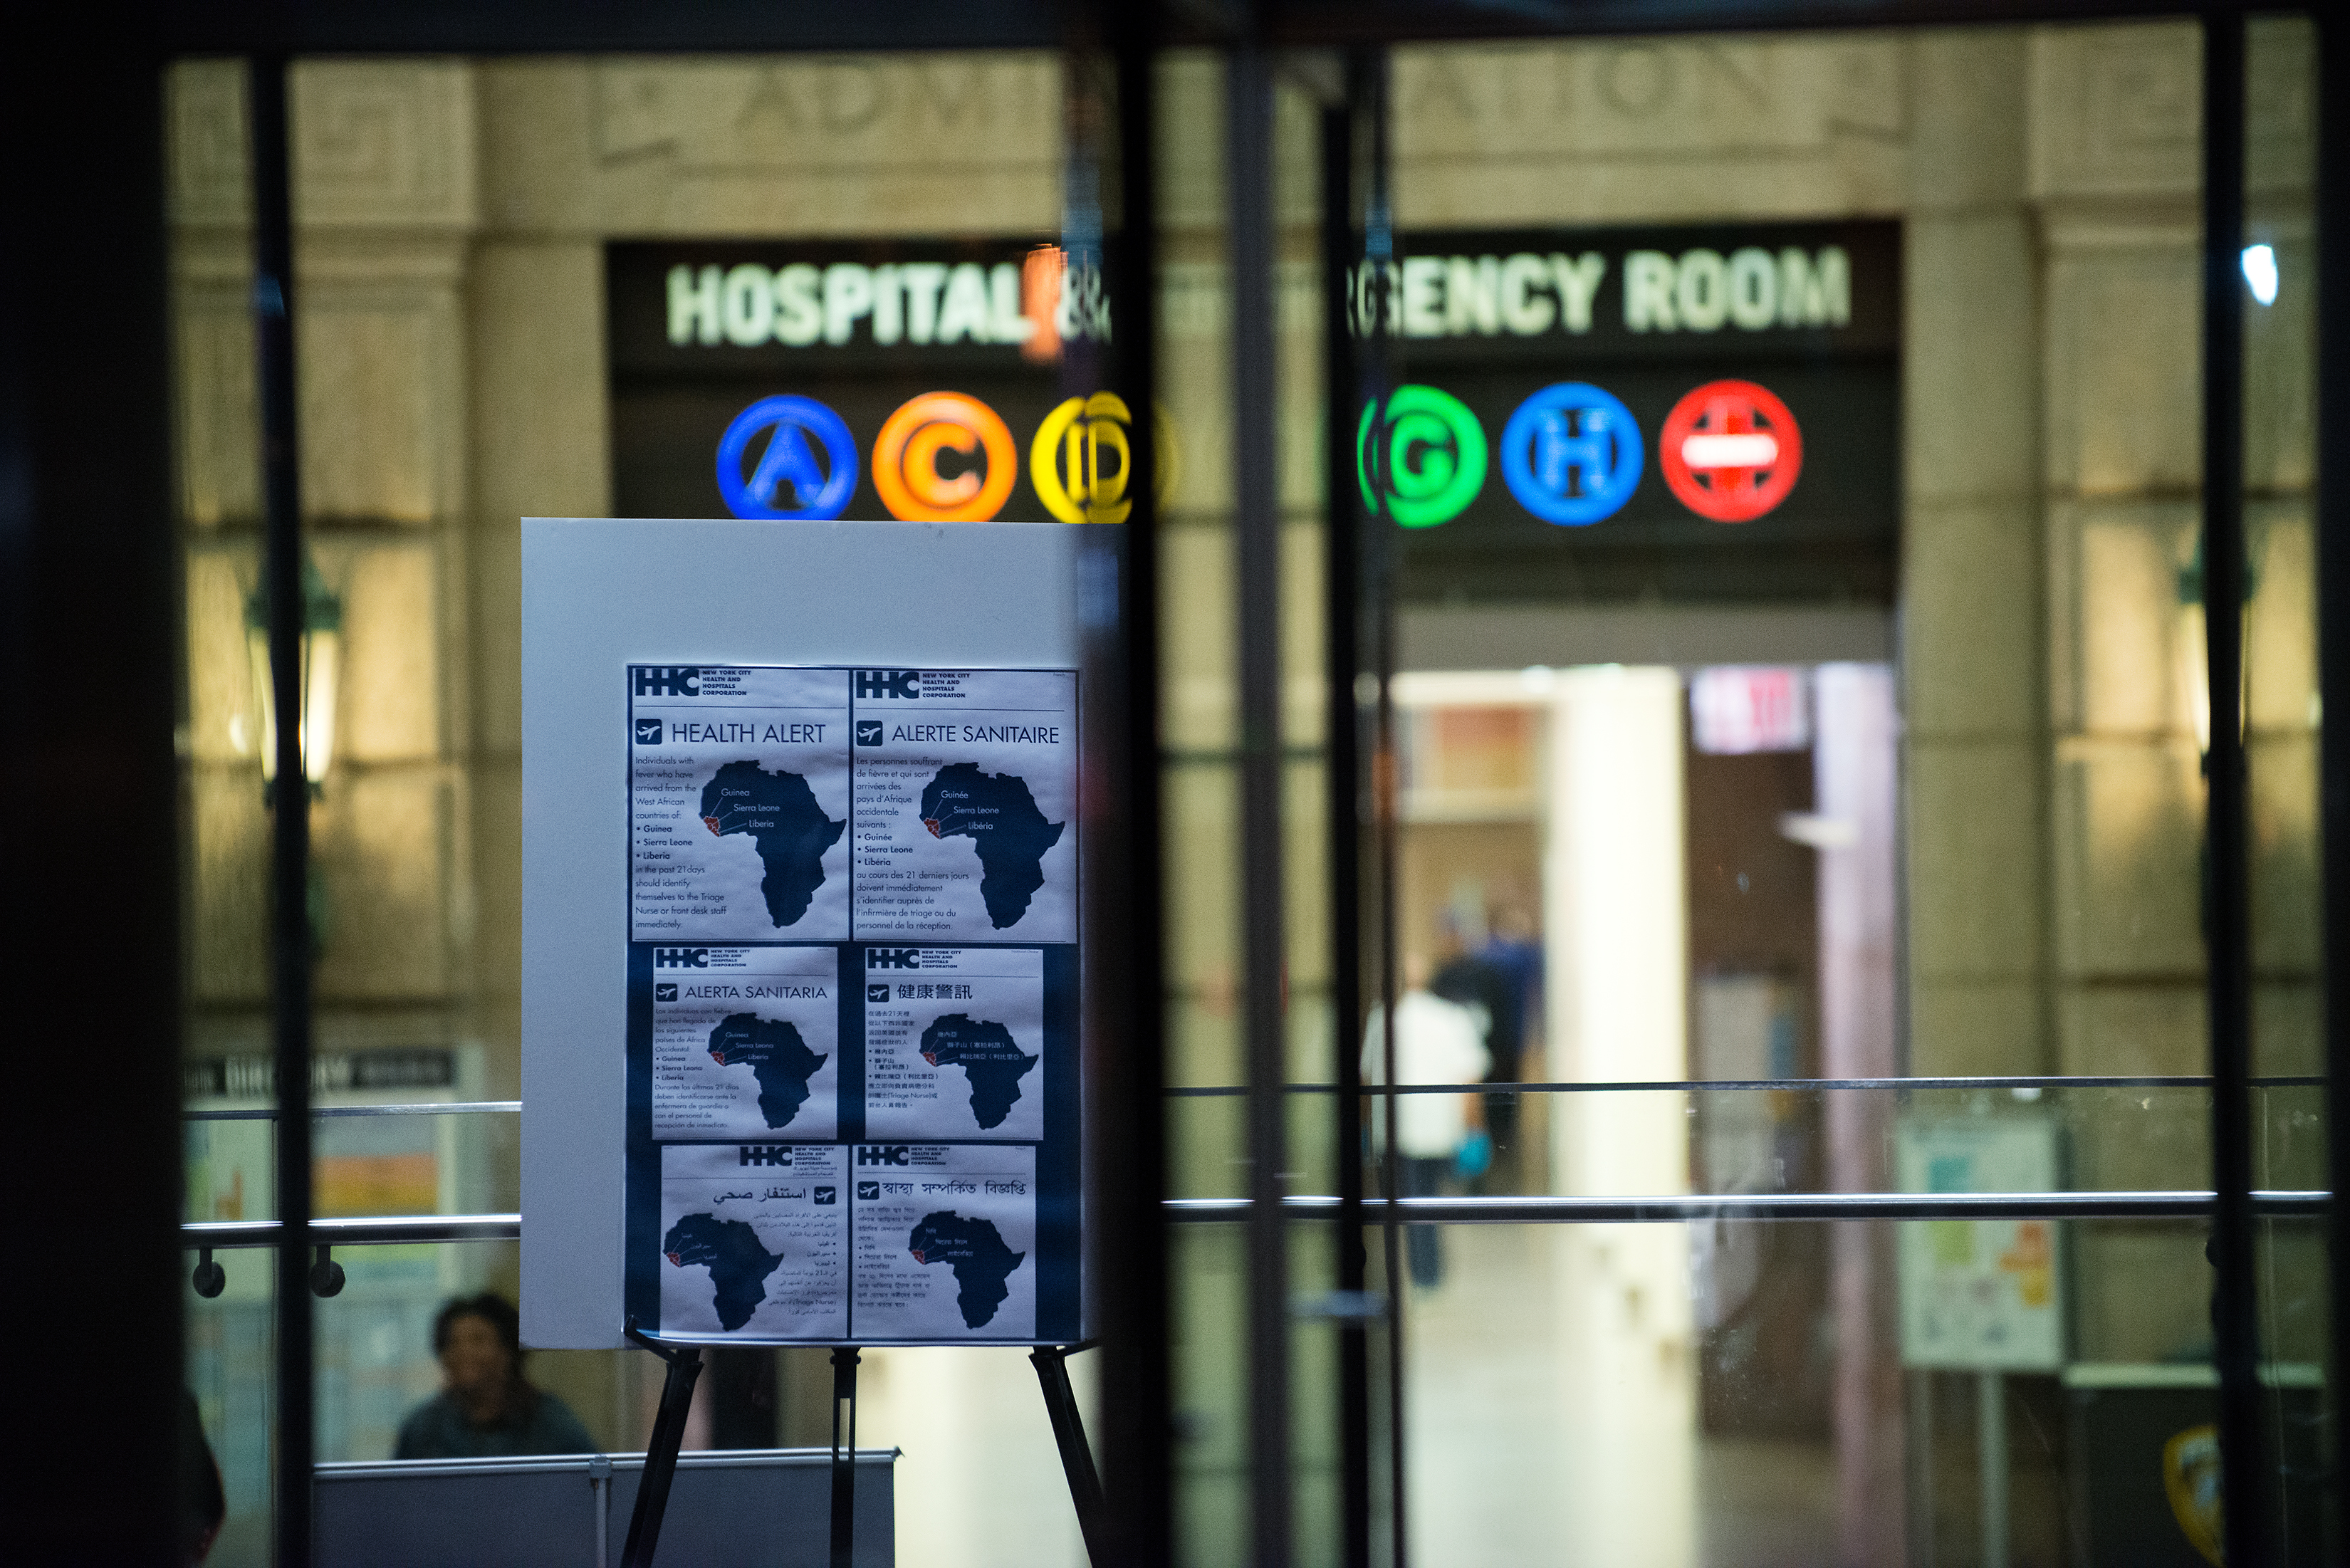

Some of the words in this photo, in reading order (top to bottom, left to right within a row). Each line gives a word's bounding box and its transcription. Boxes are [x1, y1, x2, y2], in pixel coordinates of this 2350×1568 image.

[666, 262, 1038, 347] HOSPITAL
[1622, 246, 1851, 333] ROOM
[635, 669, 699, 696] HHC
[856, 671, 919, 699] HHC
[672, 723, 754, 743] HEALTH
[763, 724, 826, 743] ALERT
[892, 725, 956, 742] ALERTE
[963, 726, 1059, 743] SANITAIRE
[635, 756, 677, 765] Individuals
[909, 756, 942, 765] souffrant
[635, 769, 654, 778] fever
[656, 770, 673, 778] who
[675, 770, 694, 778] have
[855, 769, 867, 778] de
[868, 769, 889, 778] fièvre
[899, 770, 912, 779] qui
[635, 783, 664, 792] arrived
[665, 783, 682, 792] from
[684, 783, 696, 792] the
[888, 781, 902, 790] des
[941, 790, 968, 799] Guinée
[657, 797, 685, 805] African
[733, 803, 756, 812] Sierra
[856, 807, 899, 816] occidentale
[954, 805, 976, 814] Sierra
[749, 819, 774, 827] Liberia
[968, 821, 993, 830] Libéria
[643, 851, 670, 859] Liberia
[865, 857, 891, 866] Libéria
[644, 864, 657, 873] the
[658, 865, 674, 875] past
[890, 870, 904, 879] des
[919, 870, 949, 879] derniers
[951, 871, 969, 881] jours
[635, 878, 661, 887] should
[662, 878, 691, 889] identify
[856, 883, 884, 892] doivent
[886, 883, 943, 892] immédiatement
[635, 892, 676, 901] themselves
[686, 892, 699, 901] the
[701, 892, 724, 903] Triage
[897, 897, 923, 906] auprès
[924, 896, 934, 904] de
[671, 905, 689, 914] front
[691, 906, 708, 914] desk
[711, 906, 727, 914] staff
[899, 908, 909, 916] de
[910, 909, 932, 919] triage
[946, 909, 956, 917] du
[856, 921, 893, 931] personnel
[894, 921, 904, 929] de
[907, 921, 914, 929] la
[656, 948, 708, 968] HHC
[867, 949, 919, 969] HHC
[685, 986, 740, 998] ALERTA
[745, 986, 827, 998] SANITARIA
[897, 984, 973, 999] 健康警訊
[740, 1146, 792, 1166] HHC
[858, 1146, 909, 1166] HHC
[714, 1191, 753, 1204] صحي
